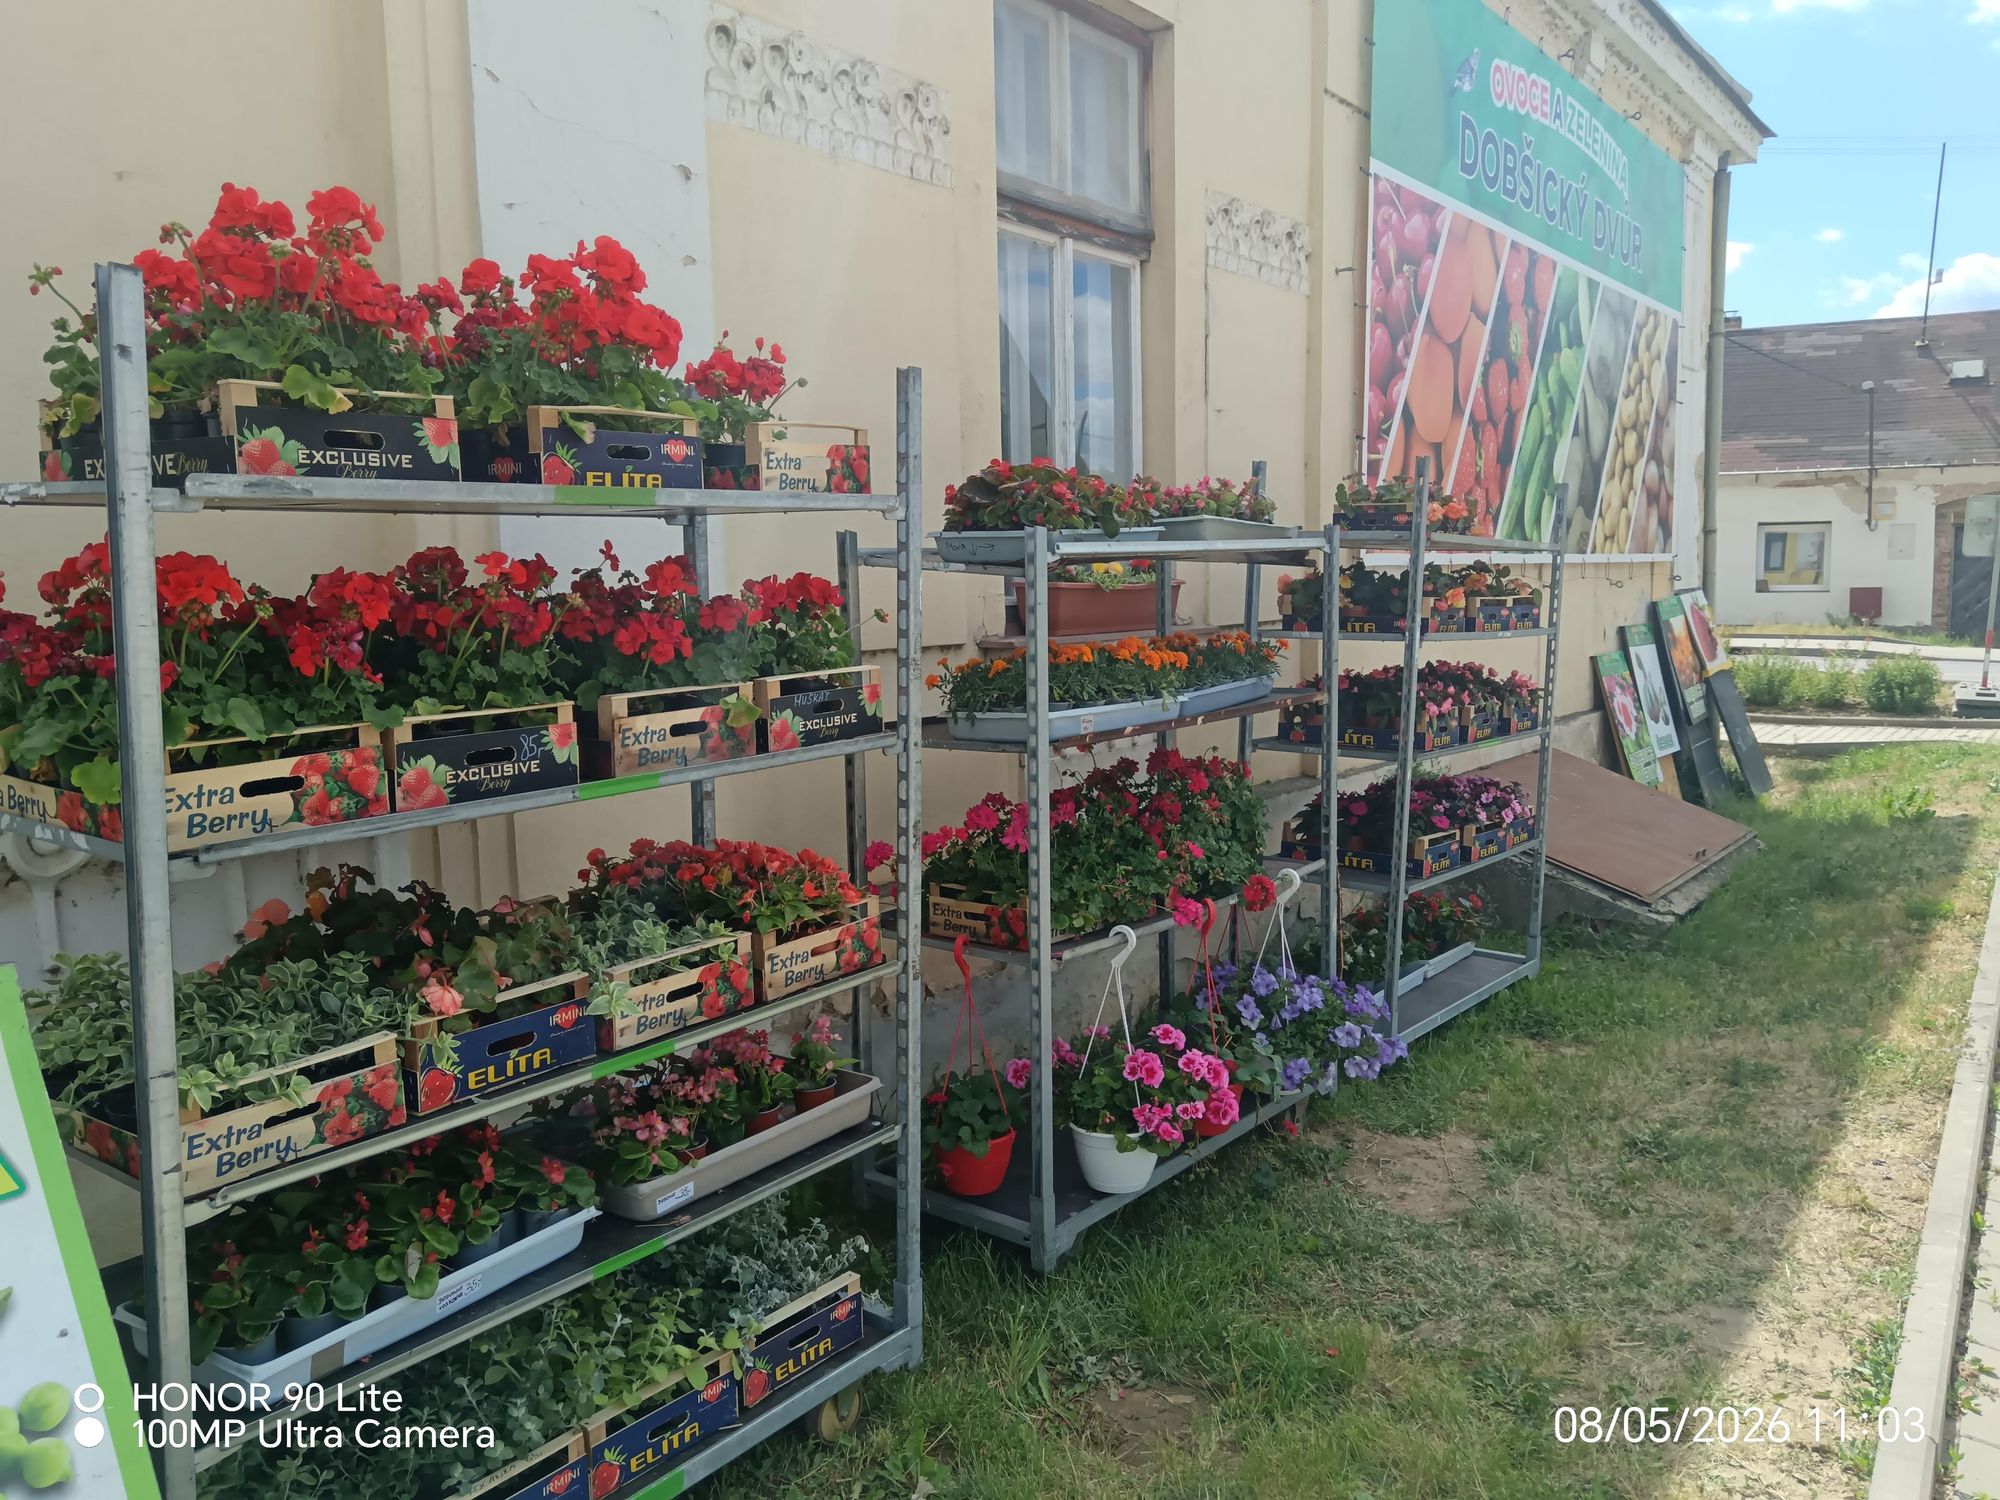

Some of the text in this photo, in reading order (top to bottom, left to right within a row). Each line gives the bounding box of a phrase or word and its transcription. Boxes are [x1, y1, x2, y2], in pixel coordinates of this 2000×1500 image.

[1491, 60, 1629, 196] OVOCE A ZELENINA
[1459, 110, 1588, 240] DOBŠICKÝ
[298, 449, 413, 468] EXCLUSIVE
[660, 443, 694, 456] IRMINI
[766, 451, 802, 471] Extra
[336, 463, 378, 480] Berry
[488, 461, 522, 476] IRMINI
[779, 472, 817, 493] Berry
[799, 712, 858, 732] EXCLUSIVE
[620, 725, 667, 749] Extra
[638, 746, 688, 768] Berry
[446, 760, 540, 784] EXCLUSIVE
[477, 778, 511, 792] Berry
[7, 784, 47, 824] Berry
[165, 783, 235, 814] Extra
[186, 808, 269, 839] Berry
[932, 902, 962, 919] Extra
[943, 918, 977, 937] Berry
[767, 950, 810, 975] Extra
[784, 963, 825, 989] Berry
[549, 1004, 587, 1027] IRMINI
[620, 993, 666, 1020] tra
[636, 1007, 687, 1036] Berry
[187, 1123, 263, 1161] Extra
[216, 1135, 293, 1177] Berry
[829, 1300, 857, 1321] IRMINI
[697, 1378, 730, 1404] IRMINI
[542, 1466, 581, 1497] IRMINI
